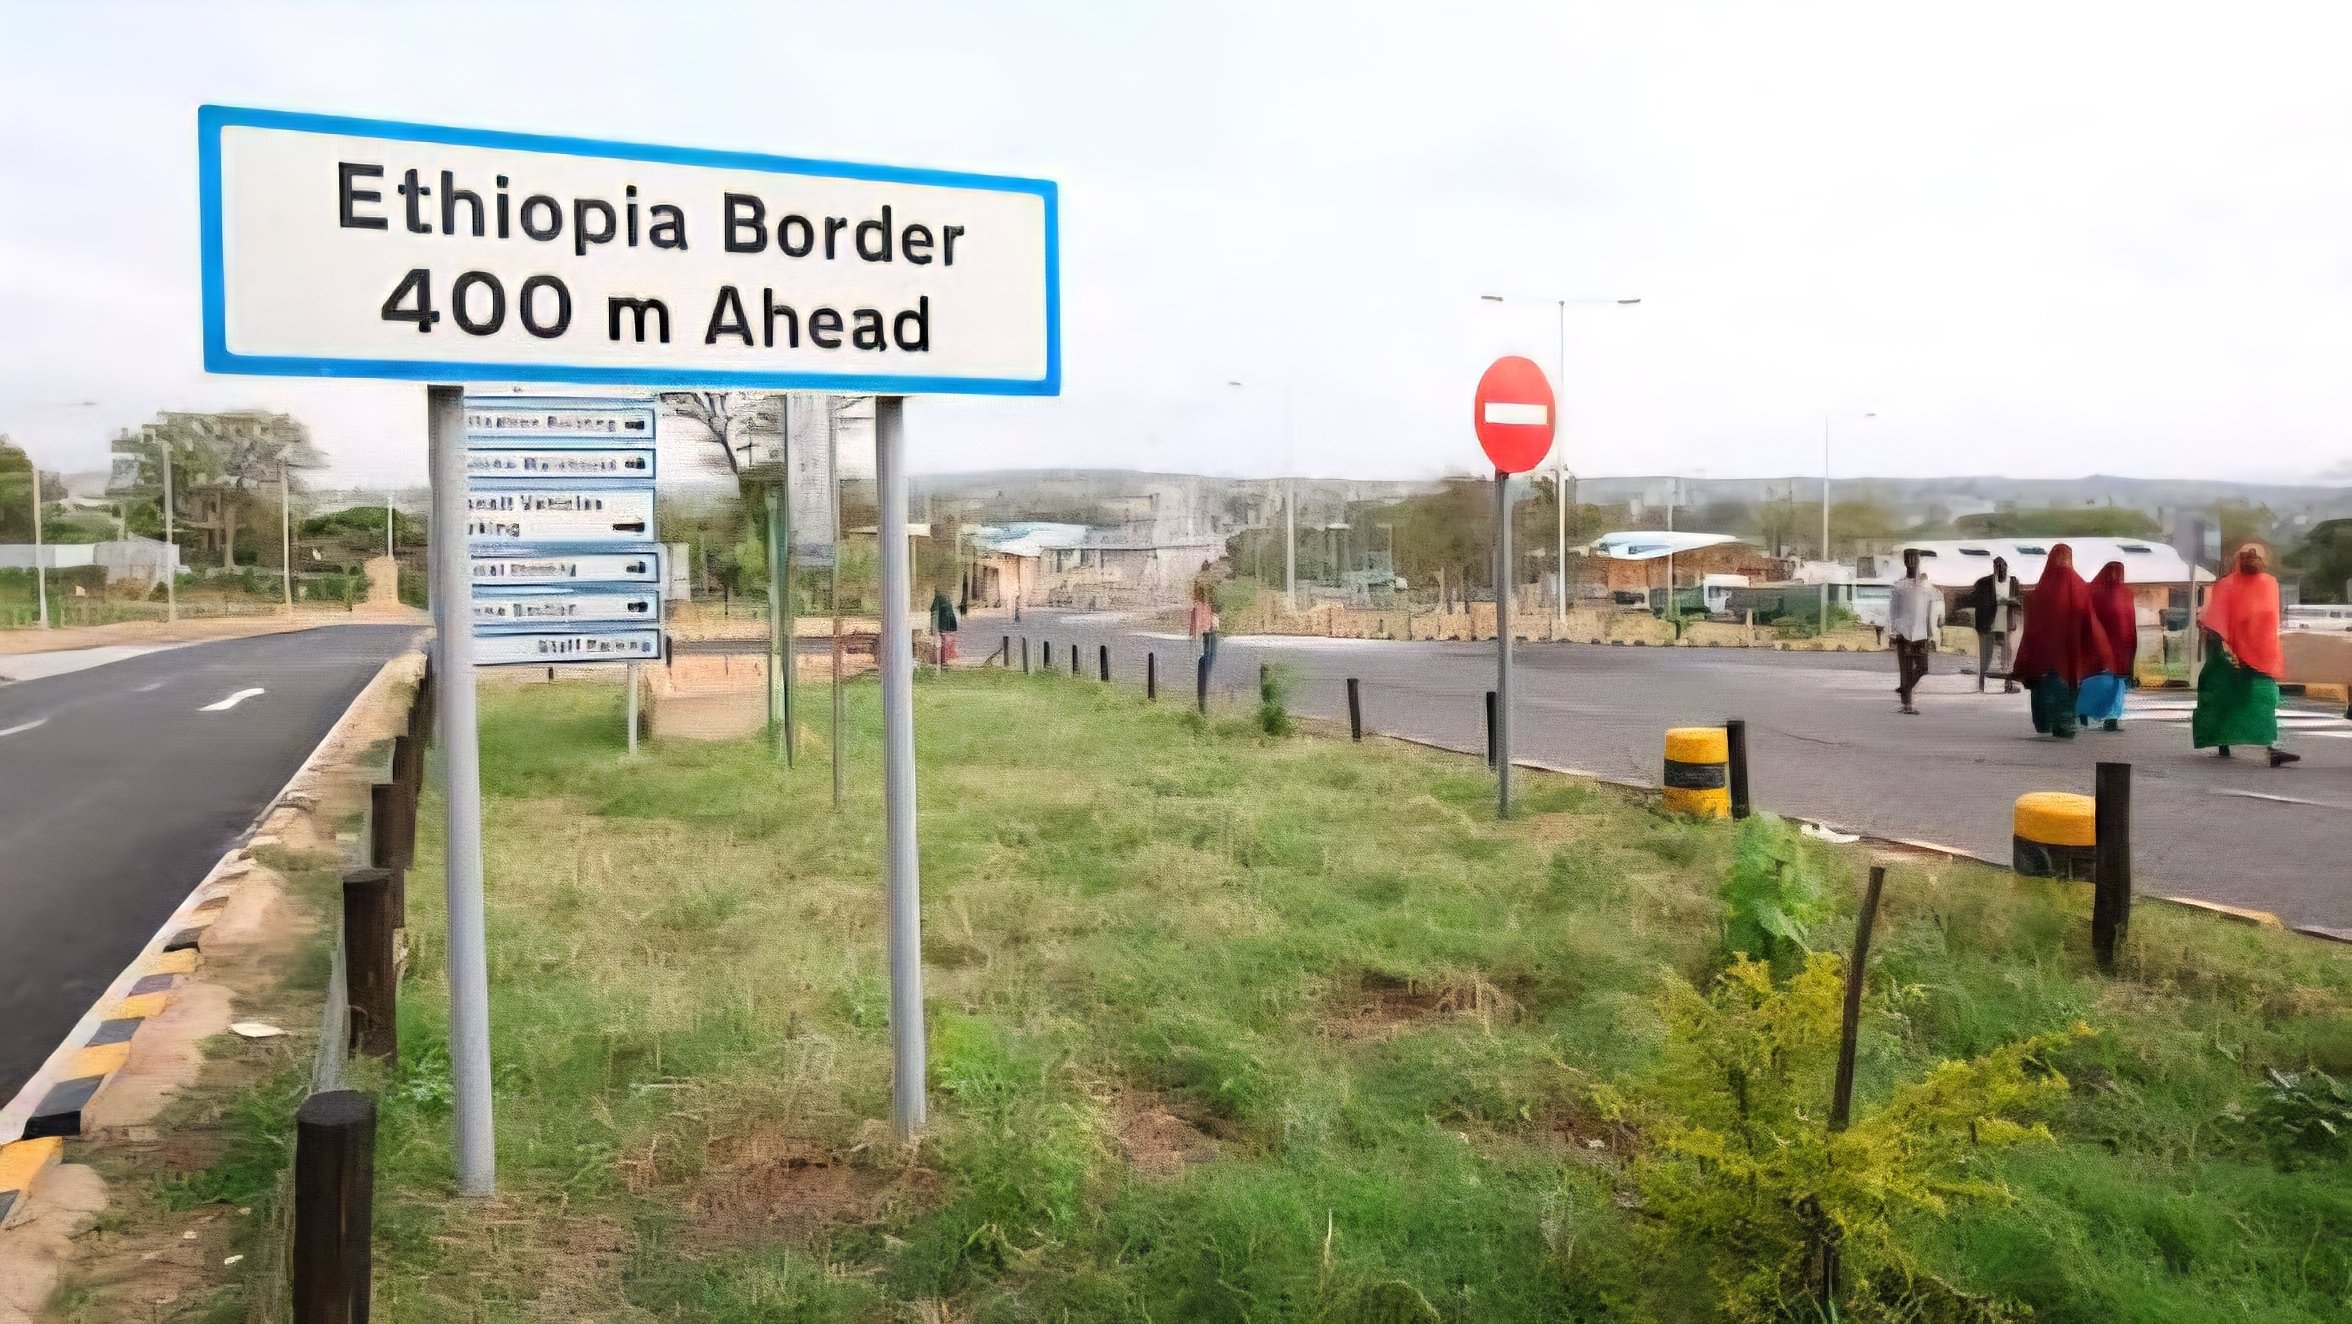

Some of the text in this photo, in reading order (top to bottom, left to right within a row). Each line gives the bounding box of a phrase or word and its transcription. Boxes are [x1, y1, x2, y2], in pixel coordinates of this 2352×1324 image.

[337, 160, 966, 267] Ethiopia Border
[380, 267, 930, 352] 400 m Ahead
